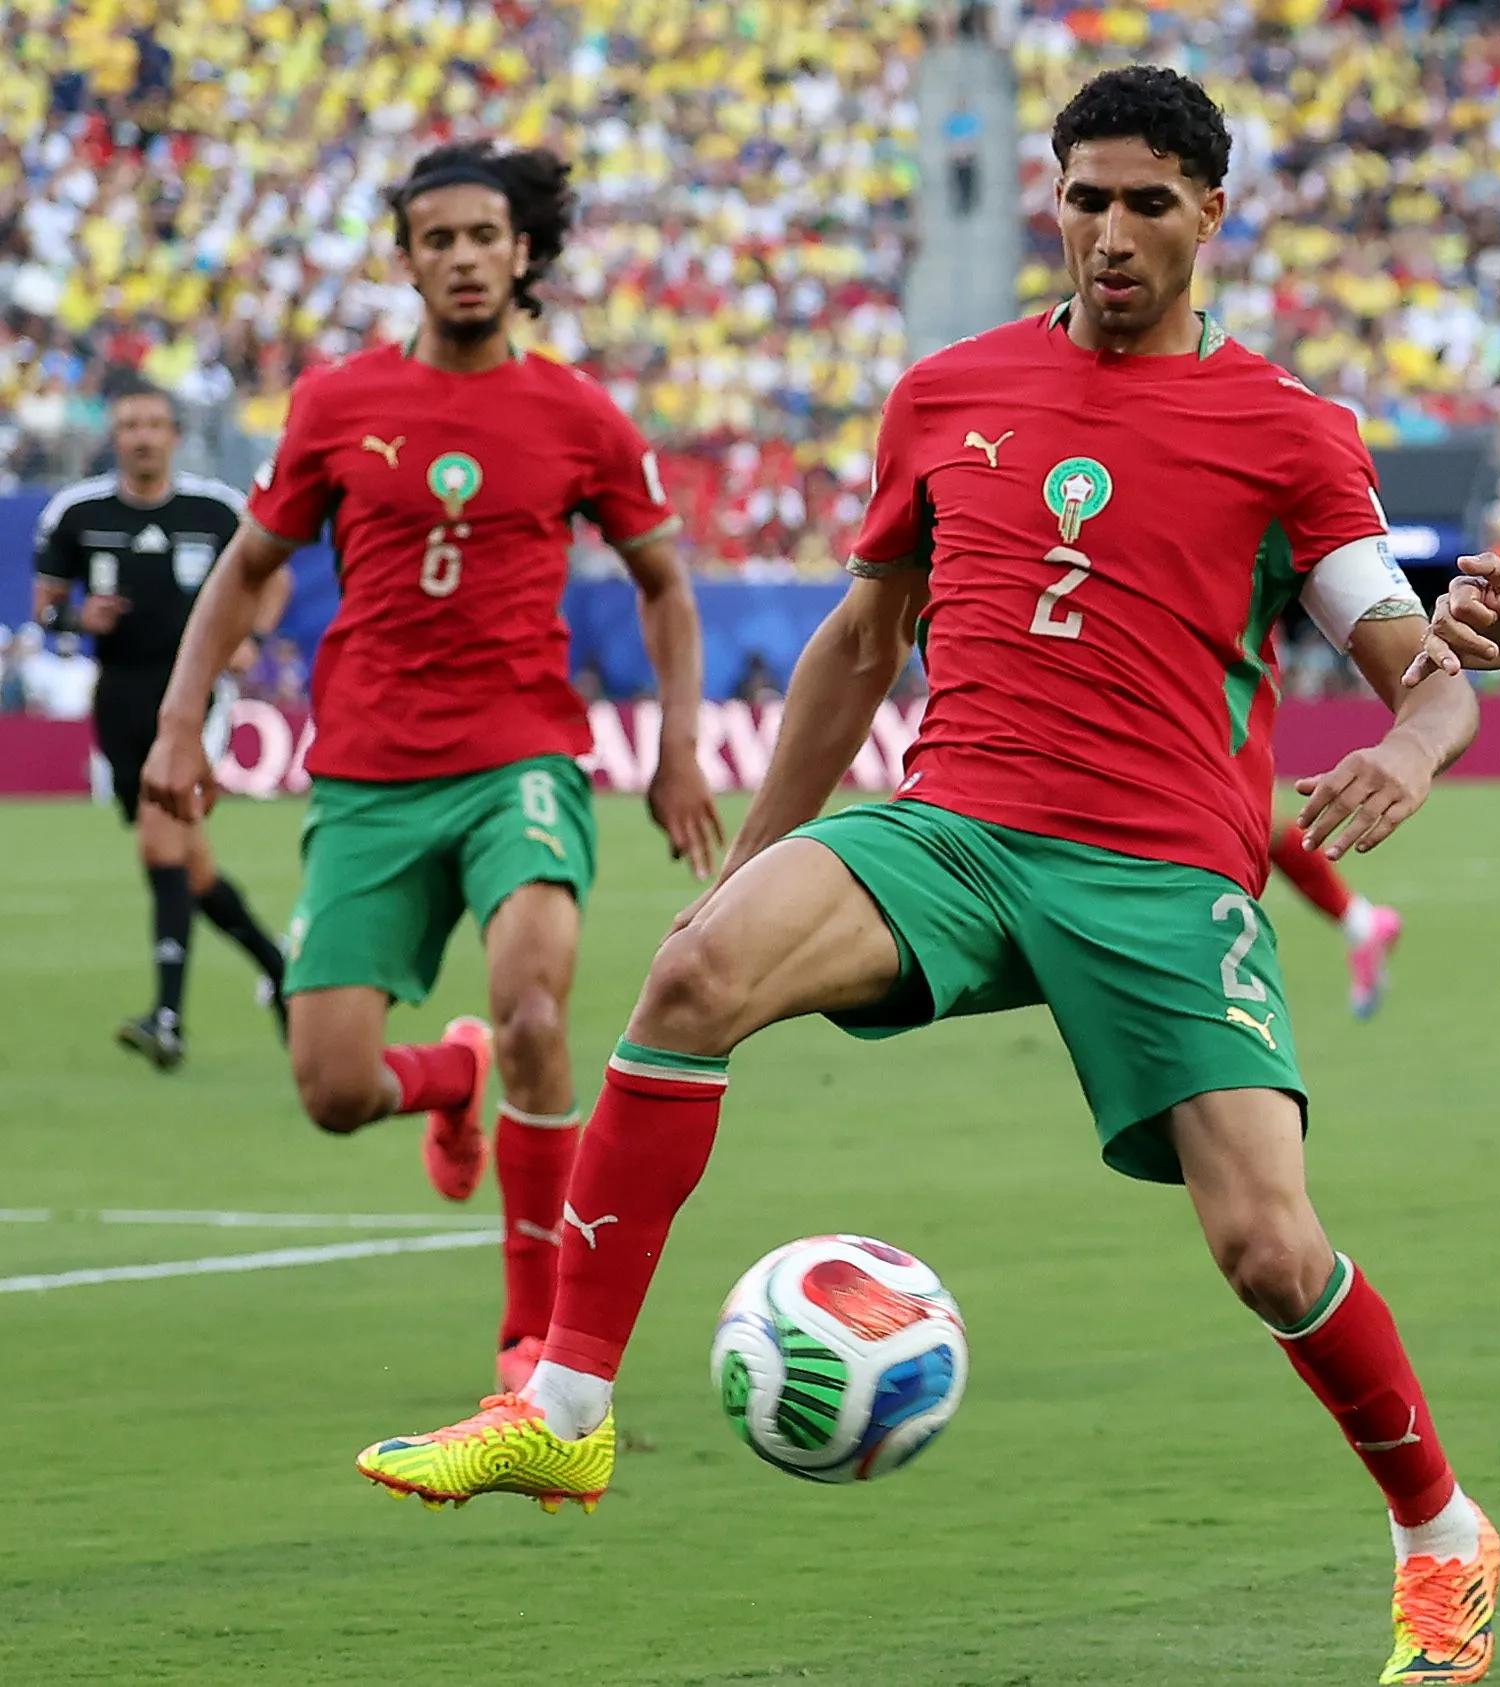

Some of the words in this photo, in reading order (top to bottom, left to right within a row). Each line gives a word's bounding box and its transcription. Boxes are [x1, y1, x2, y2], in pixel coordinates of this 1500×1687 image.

[419, 522, 472, 598] 6
[1028, 545, 1092, 640] 2
[1211, 892, 1267, 1002] 2
